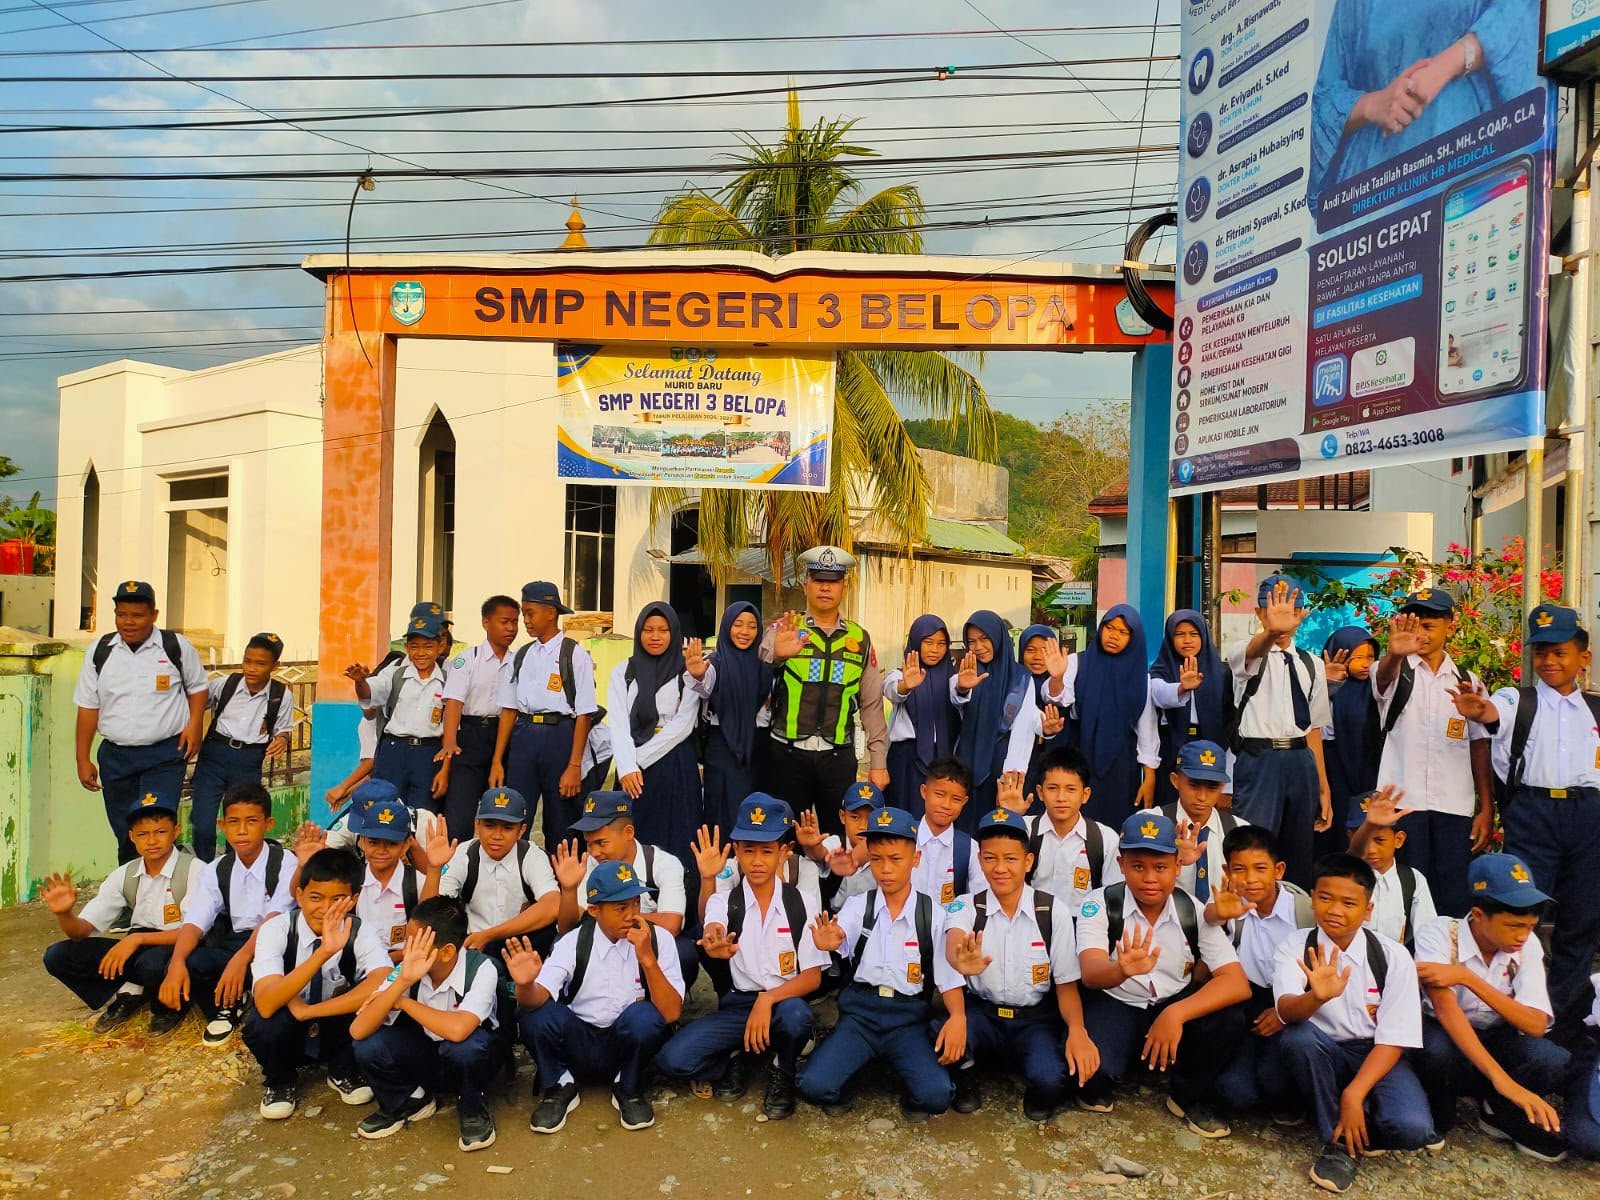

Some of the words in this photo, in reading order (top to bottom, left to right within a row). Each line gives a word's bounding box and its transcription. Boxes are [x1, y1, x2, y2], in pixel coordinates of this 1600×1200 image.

[1221, 32, 1235, 47] drg.
[1219, 102, 1229, 115] dr.
[1266, 60, 1290, 86] S.Ked
[1217, 169, 1228, 181] dr.
[1229, 152, 1258, 176] Asrapia
[1259, 127, 1304, 159] Hubaisying
[1322, 194, 1340, 212] Andi
[1514, 103, 1536, 124] CLA
[1352, 186, 1396, 216] DIREKTUR
[1397, 171, 1429, 194] KLINIK
[1431, 164, 1445, 180] HB
[1447, 143, 1496, 172] MEDICAL
[1215, 234, 1225, 247] dr.
[1226, 220, 1252, 242] Fitriani
[1253, 207, 1282, 231] Syawal,
[1283, 195, 1307, 216] S.Ked
[1317, 234, 1372, 272] SOLUSI
[1377, 210, 1432, 249] CEPAT
[1316, 288, 1340, 305] RAWAT
[1342, 280, 1365, 295] JALAN
[1367, 271, 1391, 287] TANPA
[1393, 261, 1417, 277] ANTRI
[1317, 265, 1367, 290] PENDAFTARAN
[1369, 250, 1405, 271] LAYANAN
[1225, 281, 1256, 298] Kesehatan
[1317, 311, 1325, 323] DI
[1326, 298, 1366, 319] FASILITAS
[1367, 281, 1419, 307] KESEHATAN
[474, 286, 585, 325] SMP
[605, 290, 798, 329] NEGERI
[816, 293, 842, 329] 3
[860, 293, 1076, 331] BELOPA
[1202, 303, 1243, 325] PEMERIKSAAN
[1244, 297, 1255, 309] KIA
[1256, 291, 1271, 305] DAN
[1201, 343, 1212, 352] CEK
[1213, 331, 1247, 348] KESEHATAN
[1247, 315, 1291, 338] MENYELURUH
[1202, 315, 1235, 336] PELAYANAN
[1236, 313, 1245, 322] KB
[1315, 331, 1332, 345] SATU
[1333, 324, 1363, 341] APLIKASI
[1201, 343, 1243, 362] ANAK/DEWASA
[1315, 342, 1347, 357] MELAYANI
[1348, 333, 1377, 349] PESERTA
[624, 362, 693, 380] Selamat
[699, 364, 762, 386] Datang
[1200, 361, 1240, 380] PEMERIKSAAN
[1241, 349, 1277, 367] KESEHATAN
[1278, 345, 1292, 357] GIGI
[664, 381, 695, 390] MURID
[697, 382, 722, 390] BARU
[1200, 385, 1216, 397] HOME
[1217, 381, 1231, 392] VISIT
[1232, 377, 1245, 388] DAN
[1242, 382, 1269, 397] MODERN
[598, 393, 633, 411] SMP
[640, 392, 700, 410] NEGERI
[706, 393, 717, 411] 3
[723, 394, 787, 417] BELOPA
[1198, 408, 1238, 426] PEMERIKSAAN
[1238, 396, 1287, 417] LABORATORIUM
[1198, 431, 1223, 444] APLIKASI
[1223, 427, 1246, 440] MOBILE
[1247, 424, 1259, 436] JKN
[1321, 416, 1339, 426] Google
[1340, 414, 1351, 423] Play
[1345, 428, 1445, 455] 0823-4653-3008
